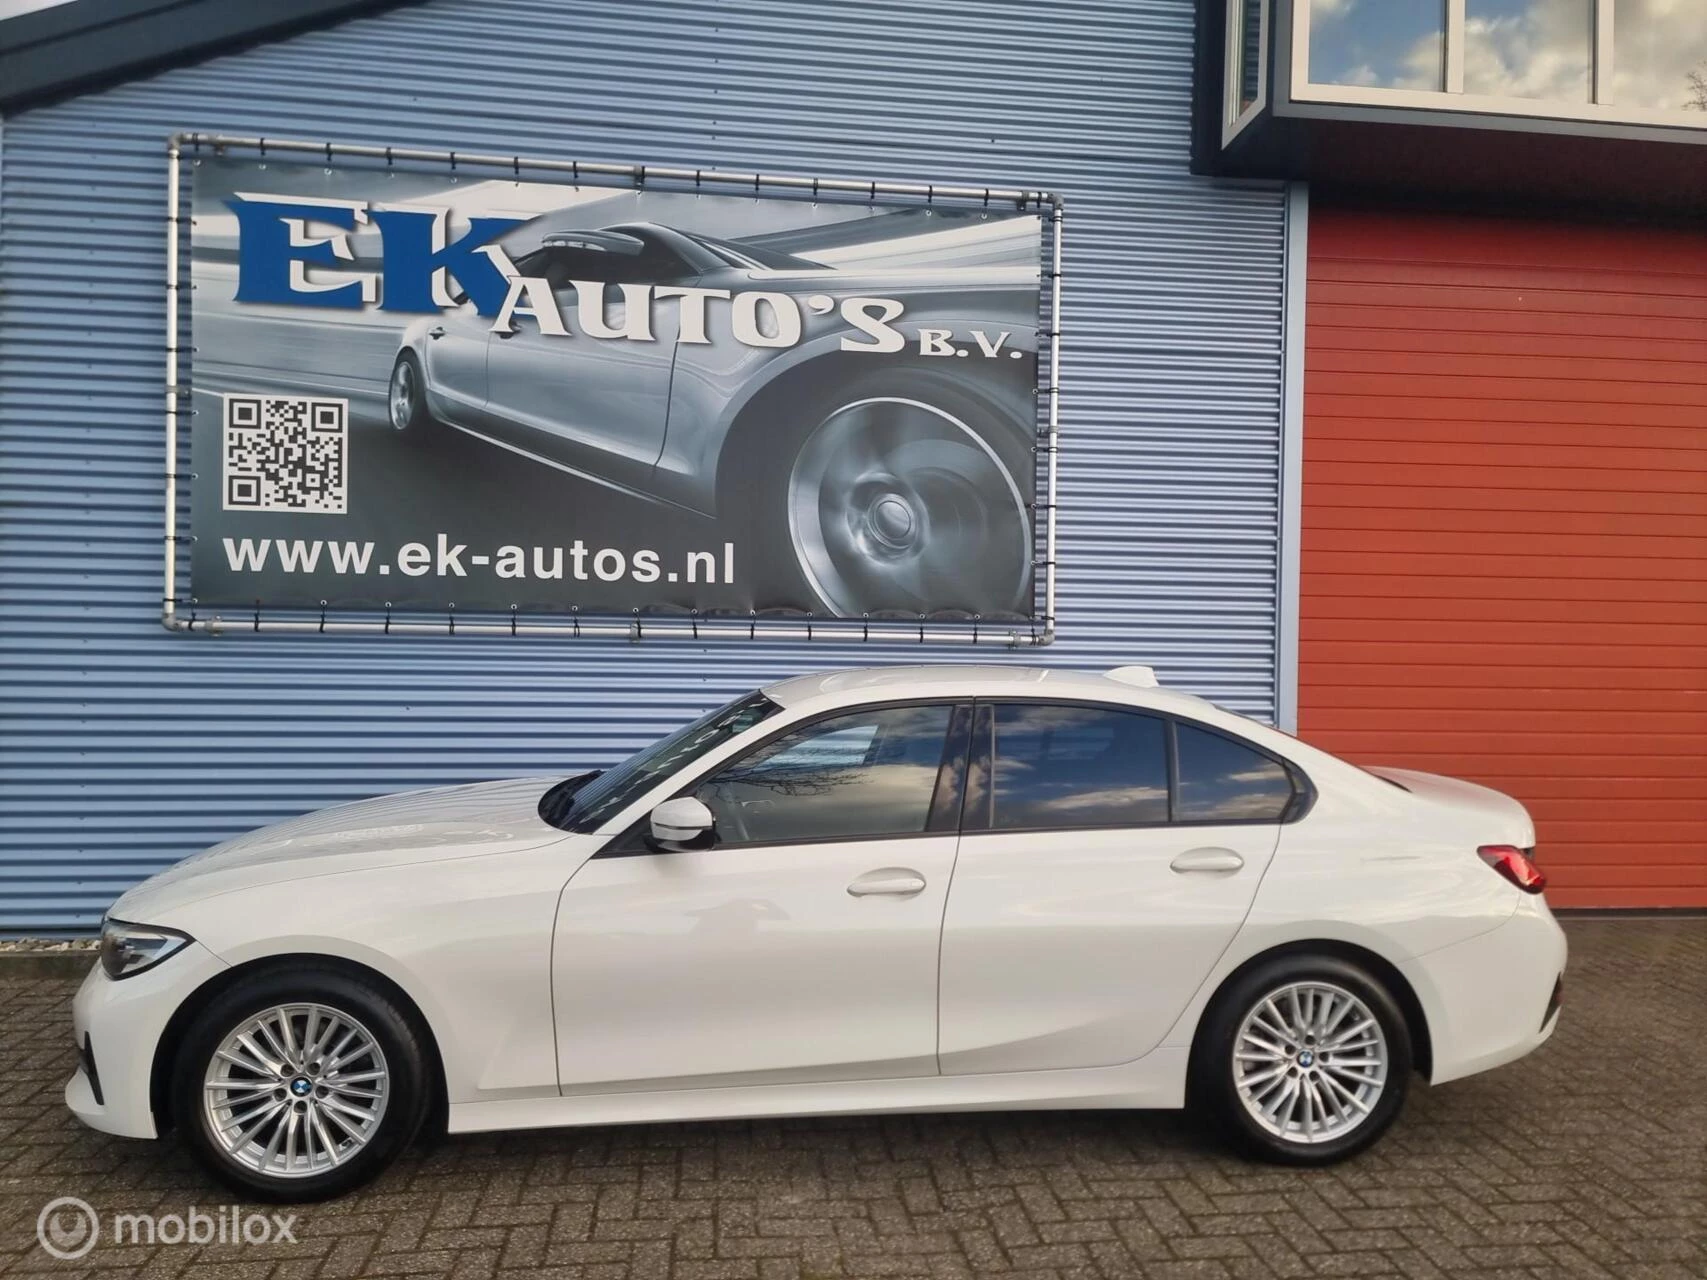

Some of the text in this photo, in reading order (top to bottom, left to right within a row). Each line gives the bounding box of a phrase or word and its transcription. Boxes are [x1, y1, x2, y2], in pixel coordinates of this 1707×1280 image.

[224, 192, 542, 318] EK
[919, 328, 1023, 359] B.V.
[222, 533, 735, 584] www.ek-autos.nl
